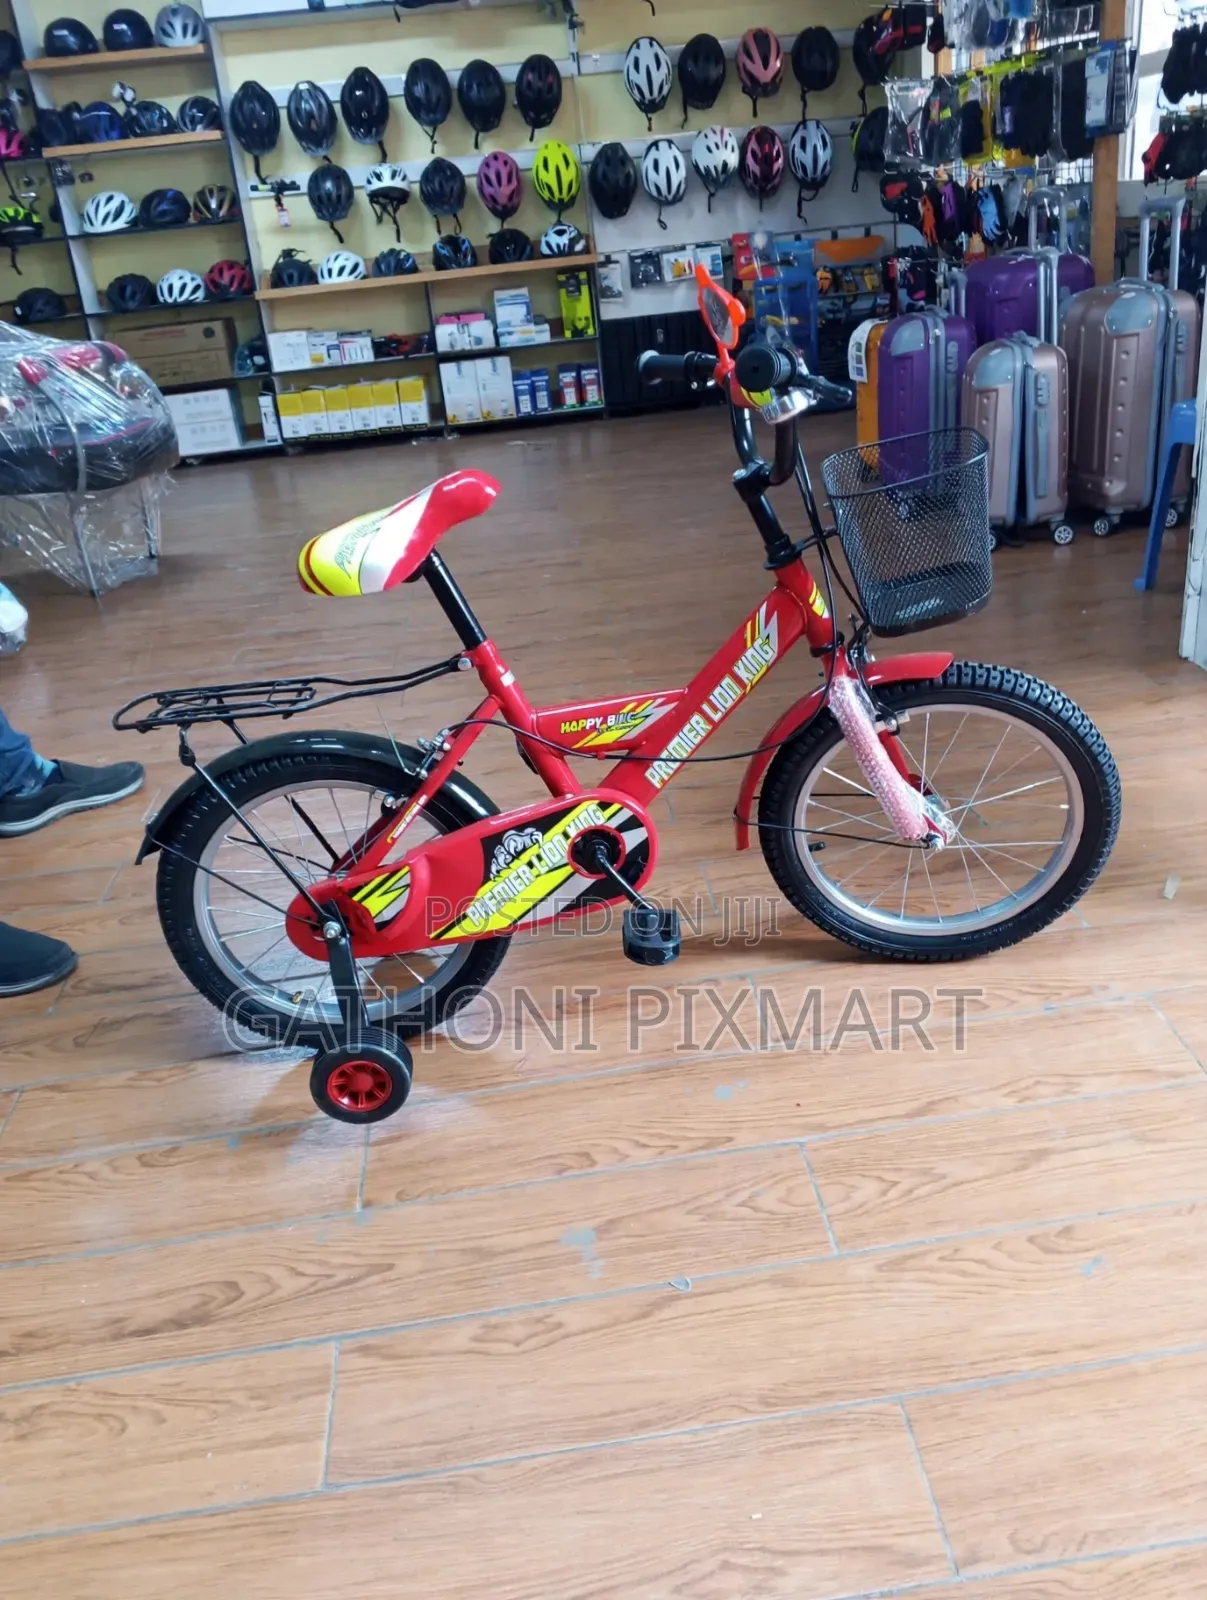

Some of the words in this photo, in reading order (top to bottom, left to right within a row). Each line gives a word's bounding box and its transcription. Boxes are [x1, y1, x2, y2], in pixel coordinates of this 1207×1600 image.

[560, 716, 603, 734] HAPPY
[644, 712, 713, 789] PREMIER
[701, 673, 744, 723] LION
[732, 637, 776, 685] KING
[465, 864, 536, 927] PREMIER
[531, 833, 569, 875] LION
